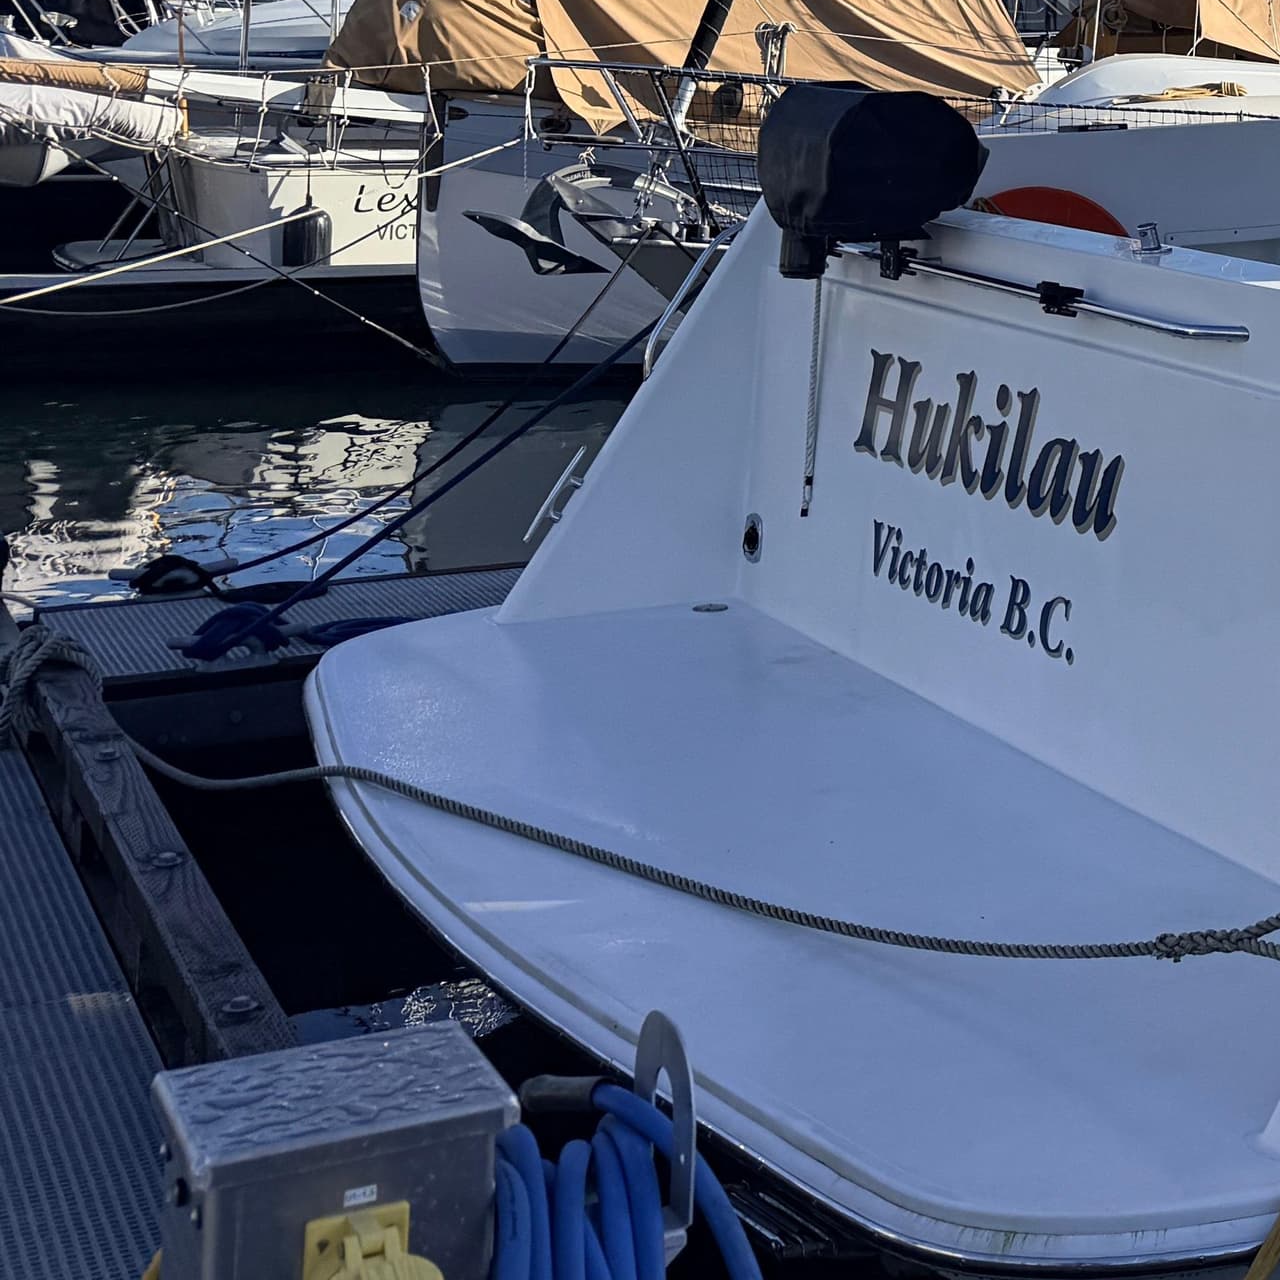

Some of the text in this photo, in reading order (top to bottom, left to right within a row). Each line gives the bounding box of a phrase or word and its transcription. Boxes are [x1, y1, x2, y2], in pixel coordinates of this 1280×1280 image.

[853, 348, 1126, 542] Hukilau
[871, 519, 1075, 665] Victoria B.C.
